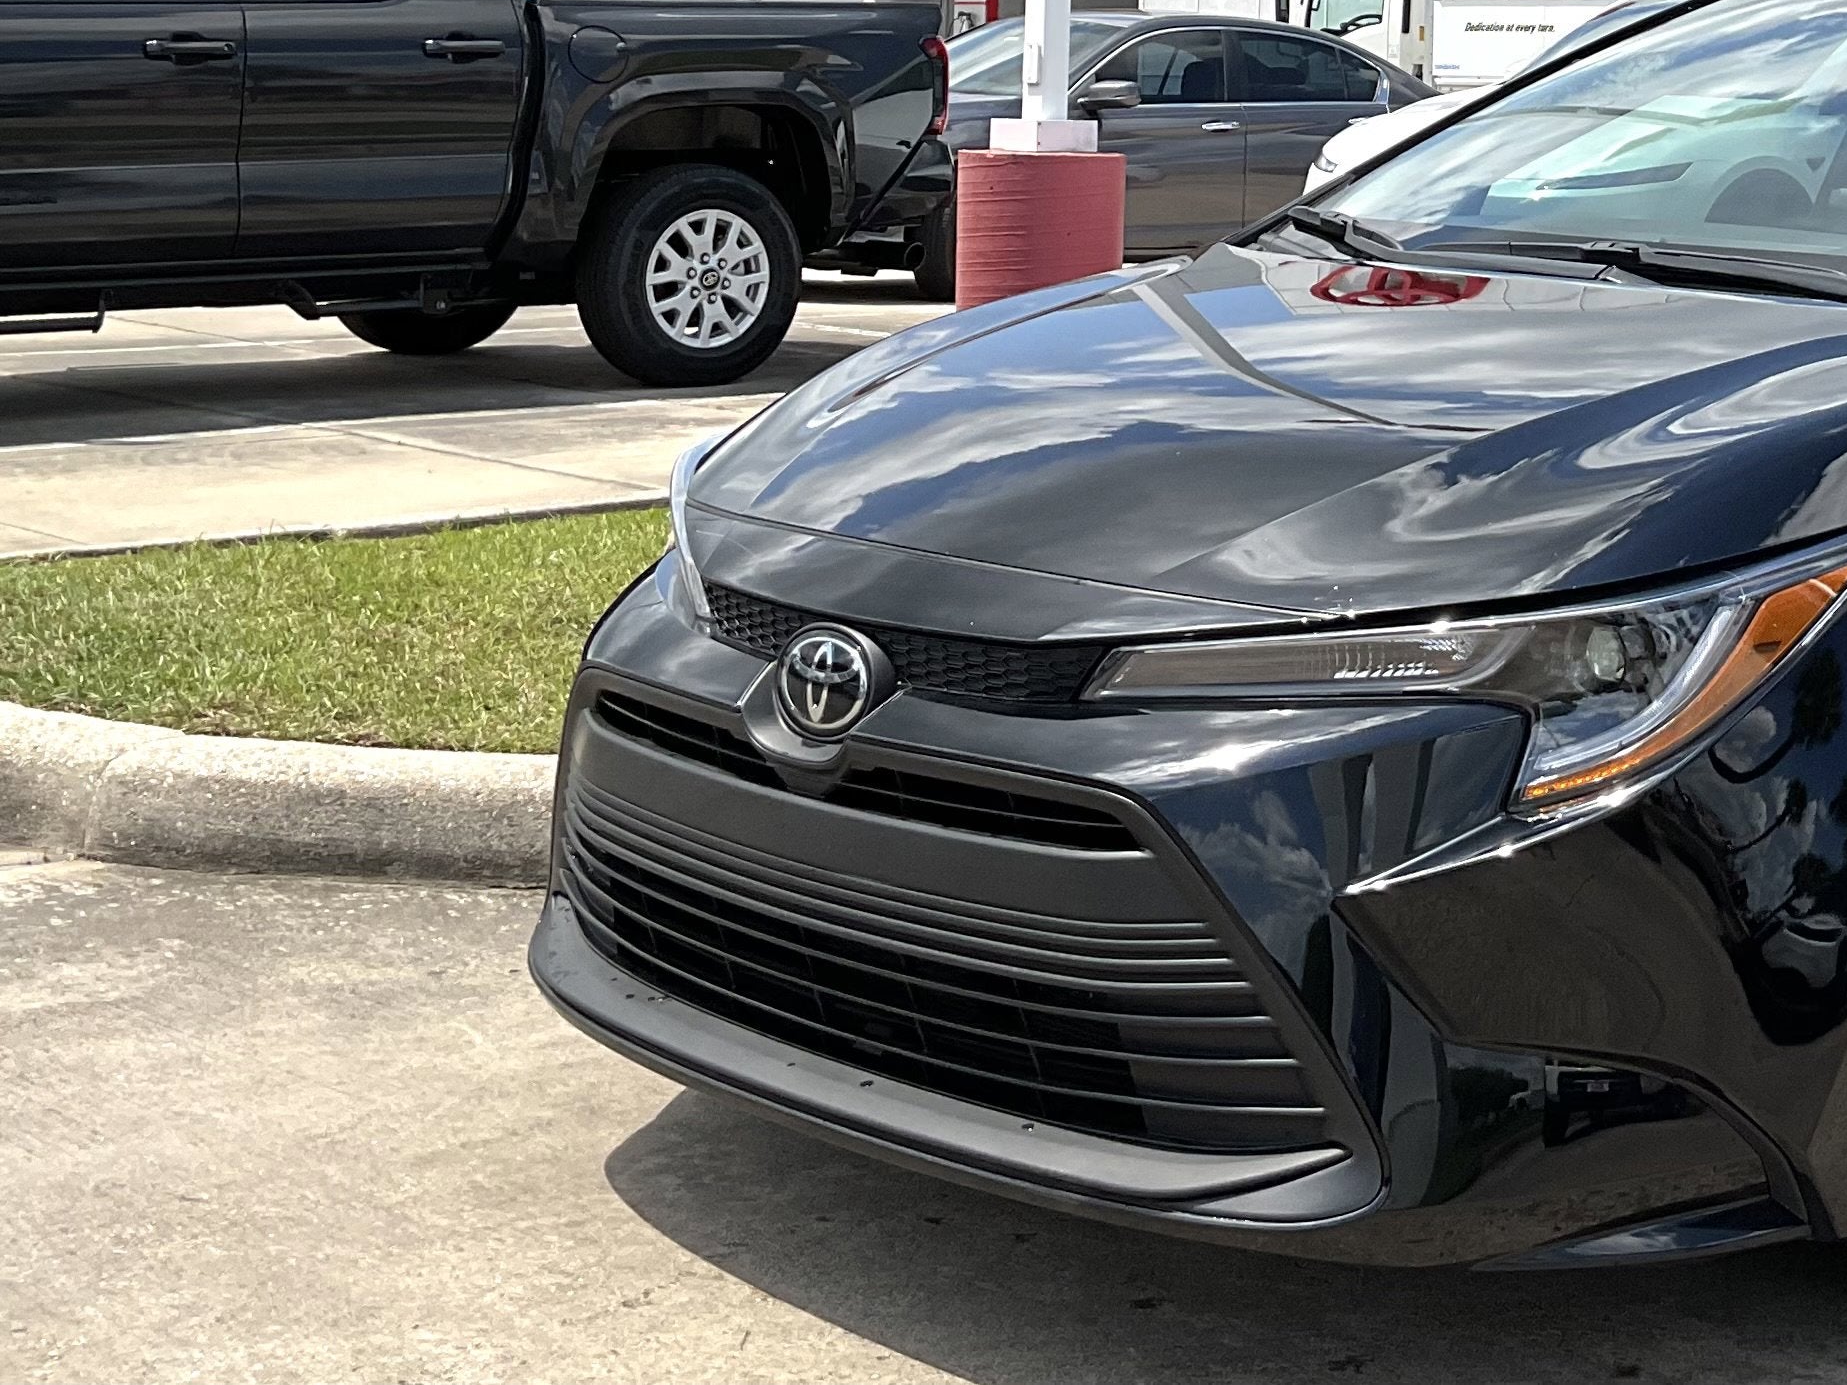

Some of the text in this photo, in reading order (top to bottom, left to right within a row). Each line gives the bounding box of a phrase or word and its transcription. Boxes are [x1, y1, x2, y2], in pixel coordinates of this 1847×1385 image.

[1464, 22, 1504, 32] Dedication
[1506, 24, 1514, 32] at
[1515, 24, 1537, 34] every
